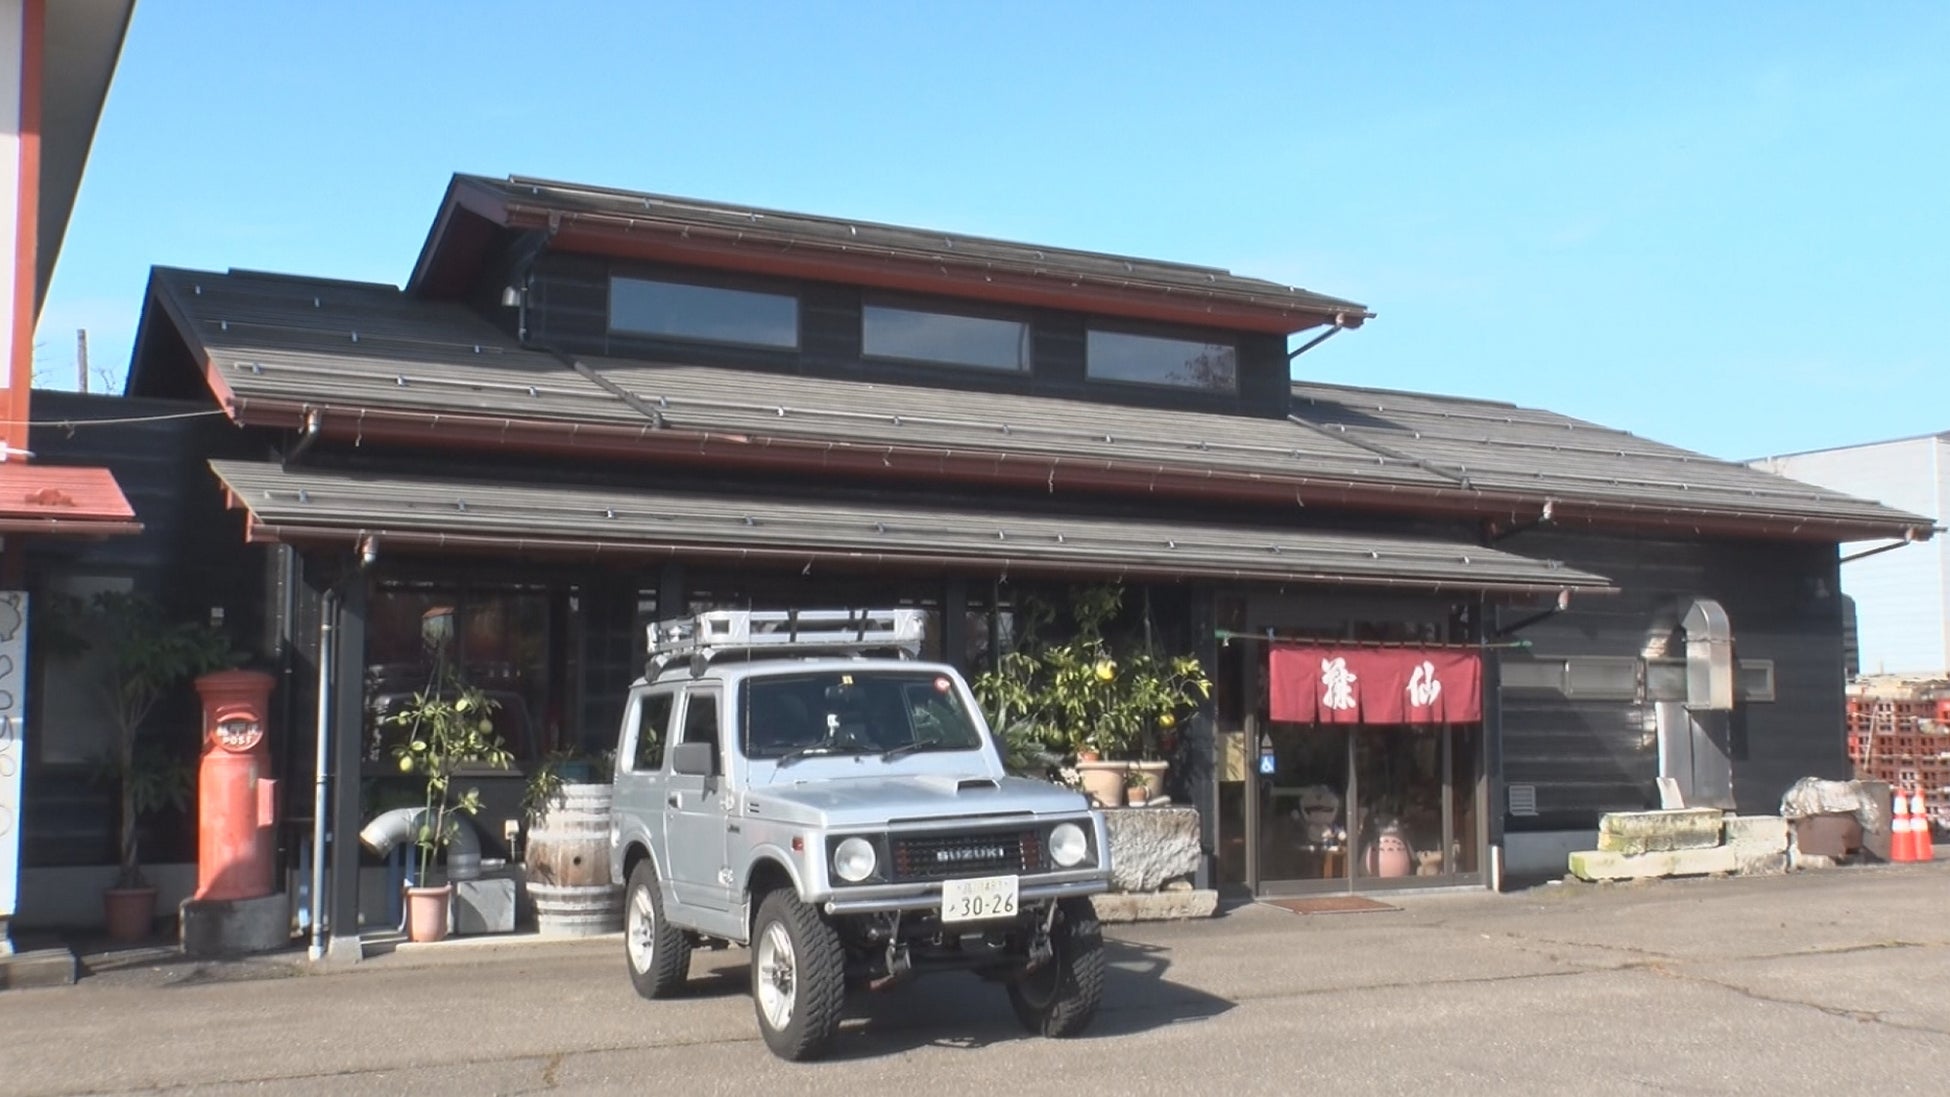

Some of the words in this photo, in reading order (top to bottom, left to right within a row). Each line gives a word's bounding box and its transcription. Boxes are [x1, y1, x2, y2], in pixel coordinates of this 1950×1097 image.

[222, 735, 254, 746] POST
[937, 847, 1005, 862] SUZUKI
[961, 892, 1014, 917] 30-26
